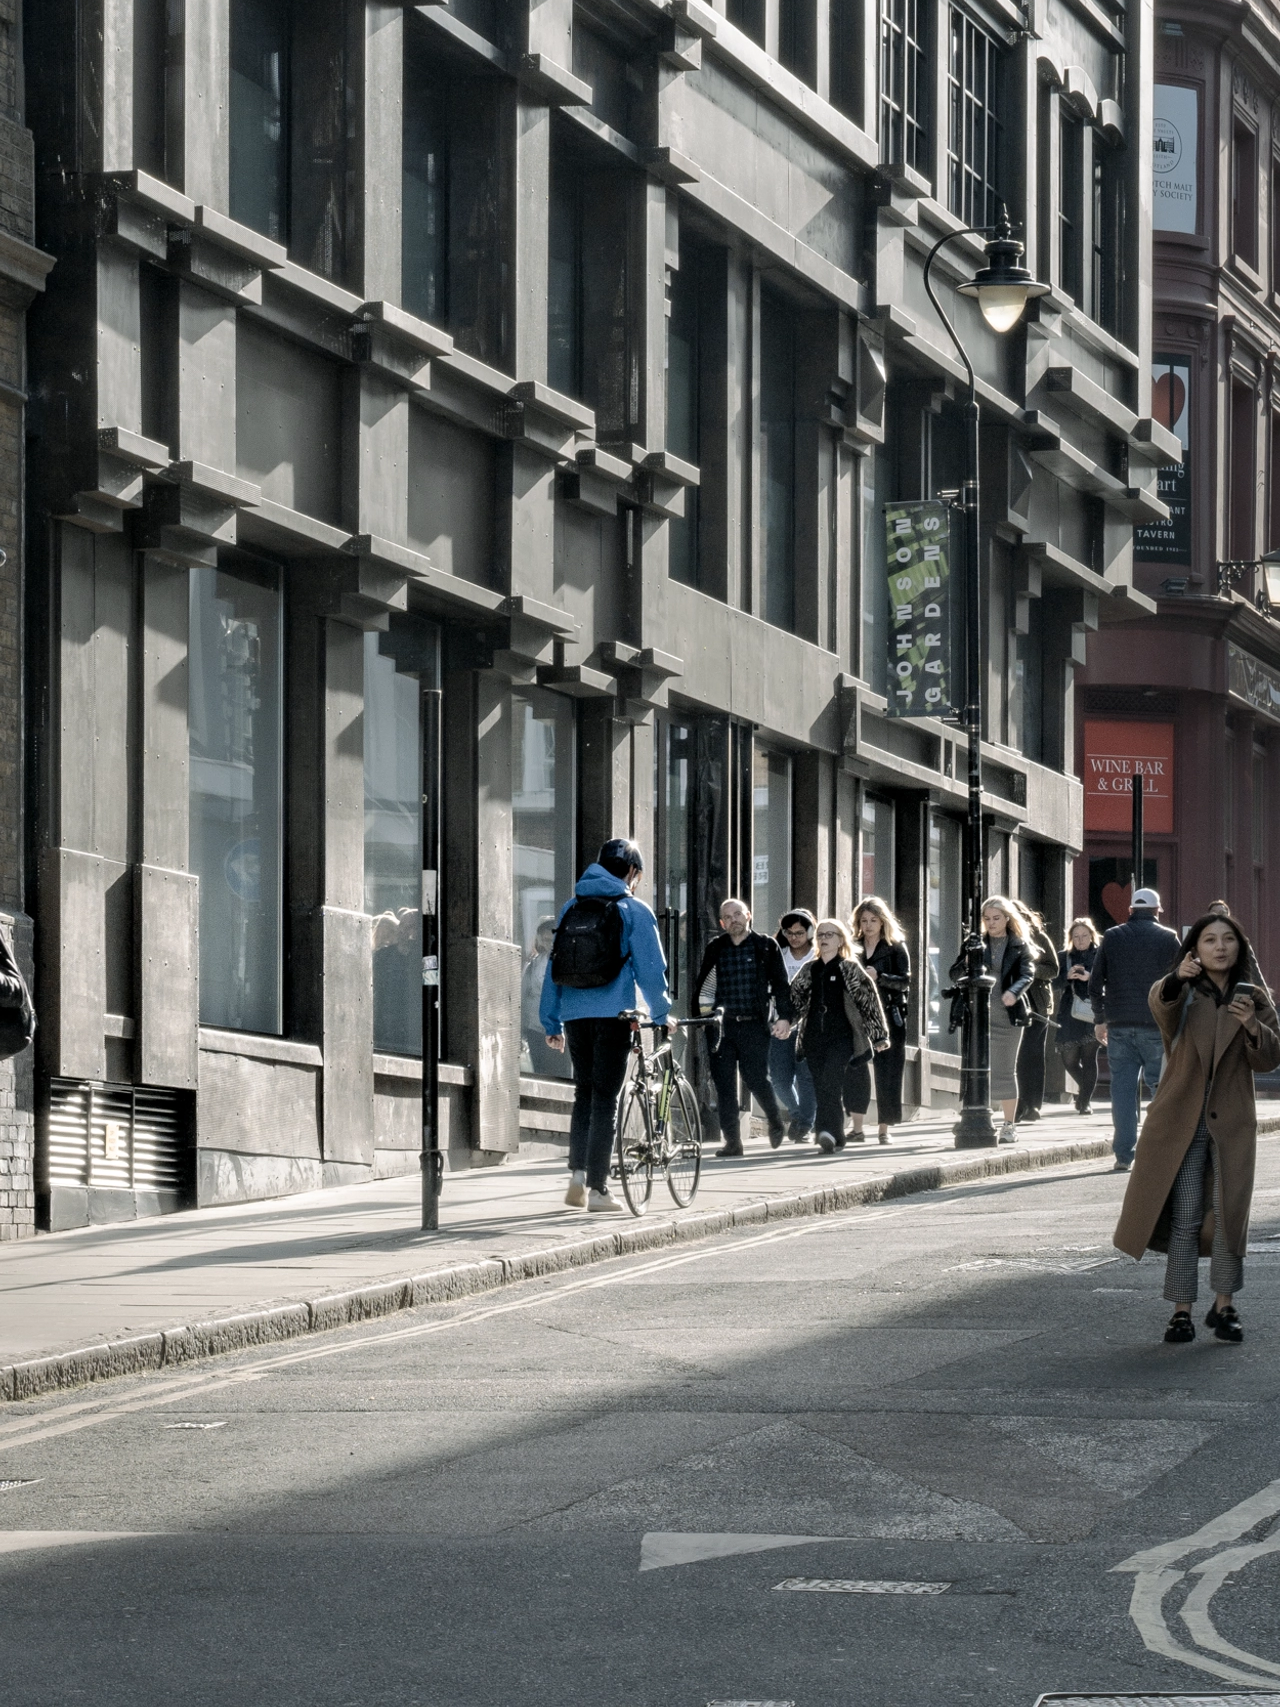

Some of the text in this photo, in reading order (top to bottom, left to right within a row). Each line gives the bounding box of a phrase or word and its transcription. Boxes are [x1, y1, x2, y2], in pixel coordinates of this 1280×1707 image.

[1174, 183, 1193, 192] MALT
[1160, 190, 1193, 201] SOCIETY
[1137, 529, 1175, 539] TAVERN
[896, 518, 913, 702] JOHNSON
[924, 517, 941, 702] GARDENS
[1090, 759, 1165, 775] WINE BAR
[1097, 777, 1109, 791] &
